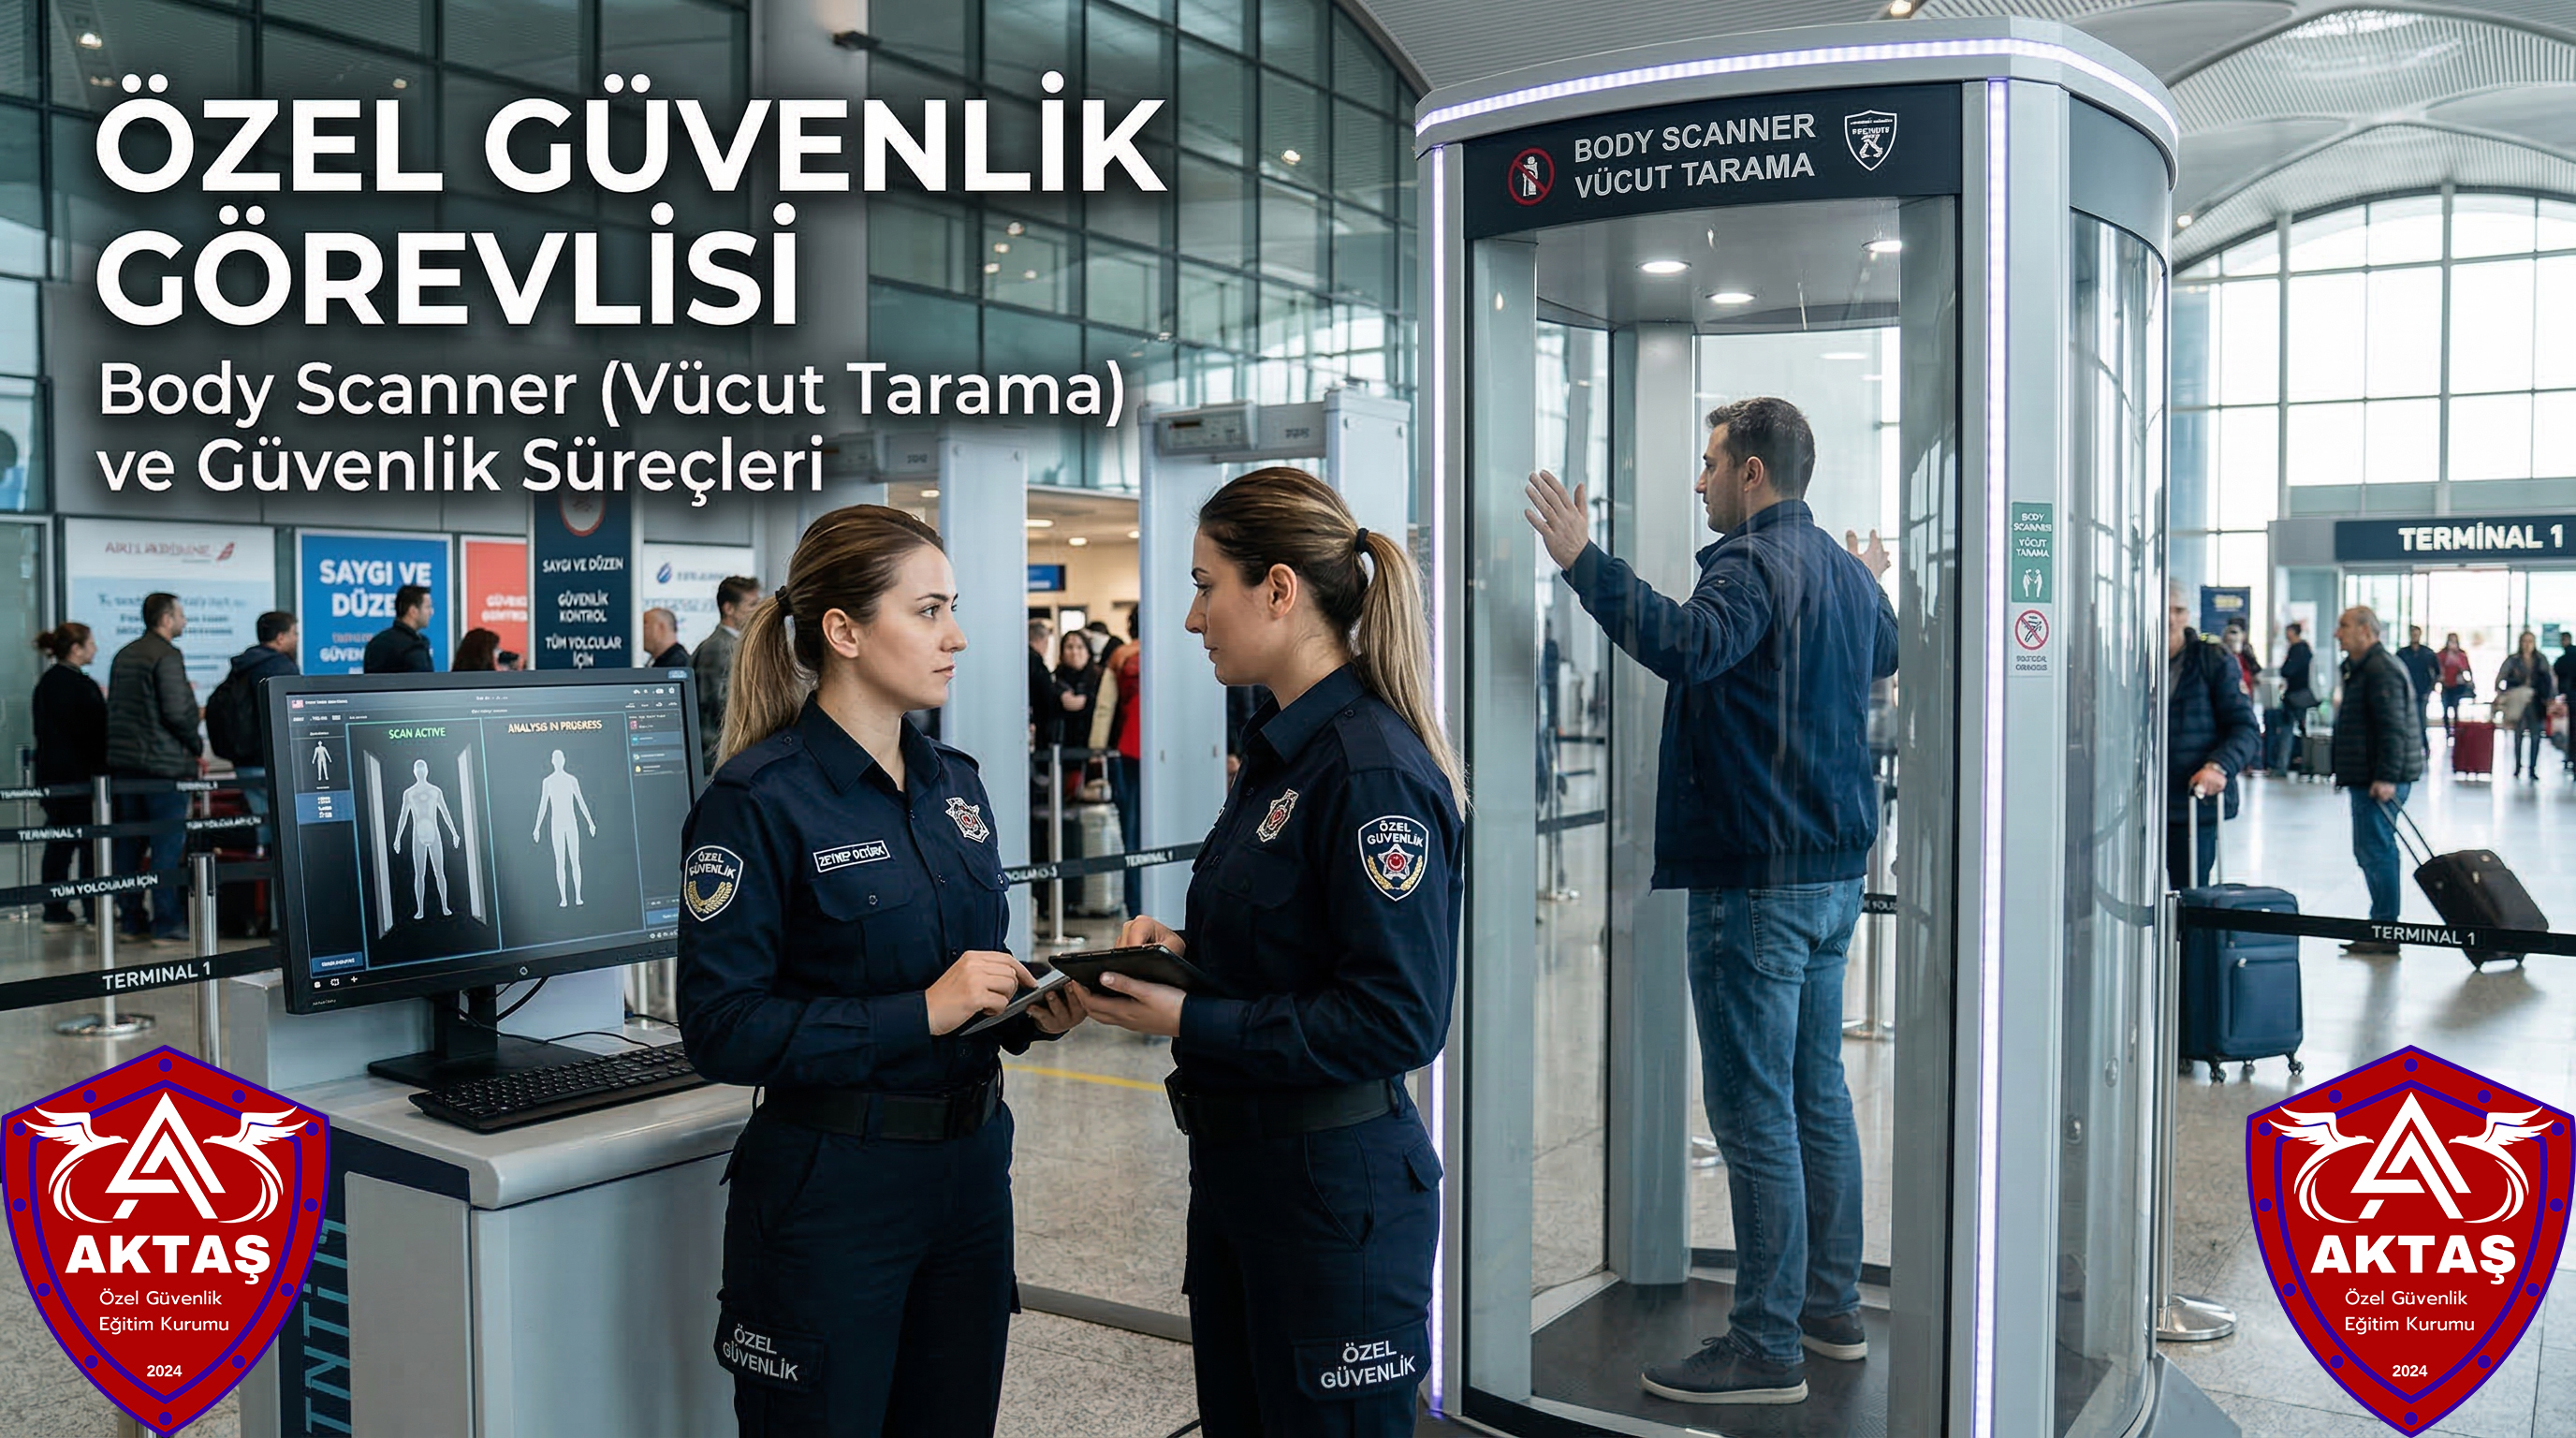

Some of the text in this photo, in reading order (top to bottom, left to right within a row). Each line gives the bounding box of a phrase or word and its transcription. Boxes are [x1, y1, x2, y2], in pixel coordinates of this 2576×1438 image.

[1574, 113, 1816, 163] BODY SCANNER
[1574, 152, 1815, 198] VÜCUT TARAMA
[2398, 521, 2563, 550] TERMİNAL 1
[319, 560, 432, 586] SAYGI VE
[331, 589, 398, 618] DÜZE
[388, 727, 446, 739] SCAN ACTIVE
[1379, 820, 1412, 832] ÖZEL
[697, 851, 724, 863] ÖZEL
[2371, 925, 2475, 946] TERMINAL 1
[102, 961, 211, 990] TERMINAL 1
[734, 1323, 777, 1355] ÖZEL
[1342, 1340, 1397, 1363] ÖZEL
[723, 1340, 798, 1382] GÜVENLİK
[1321, 1354, 1416, 1388] GÜVENLİK
